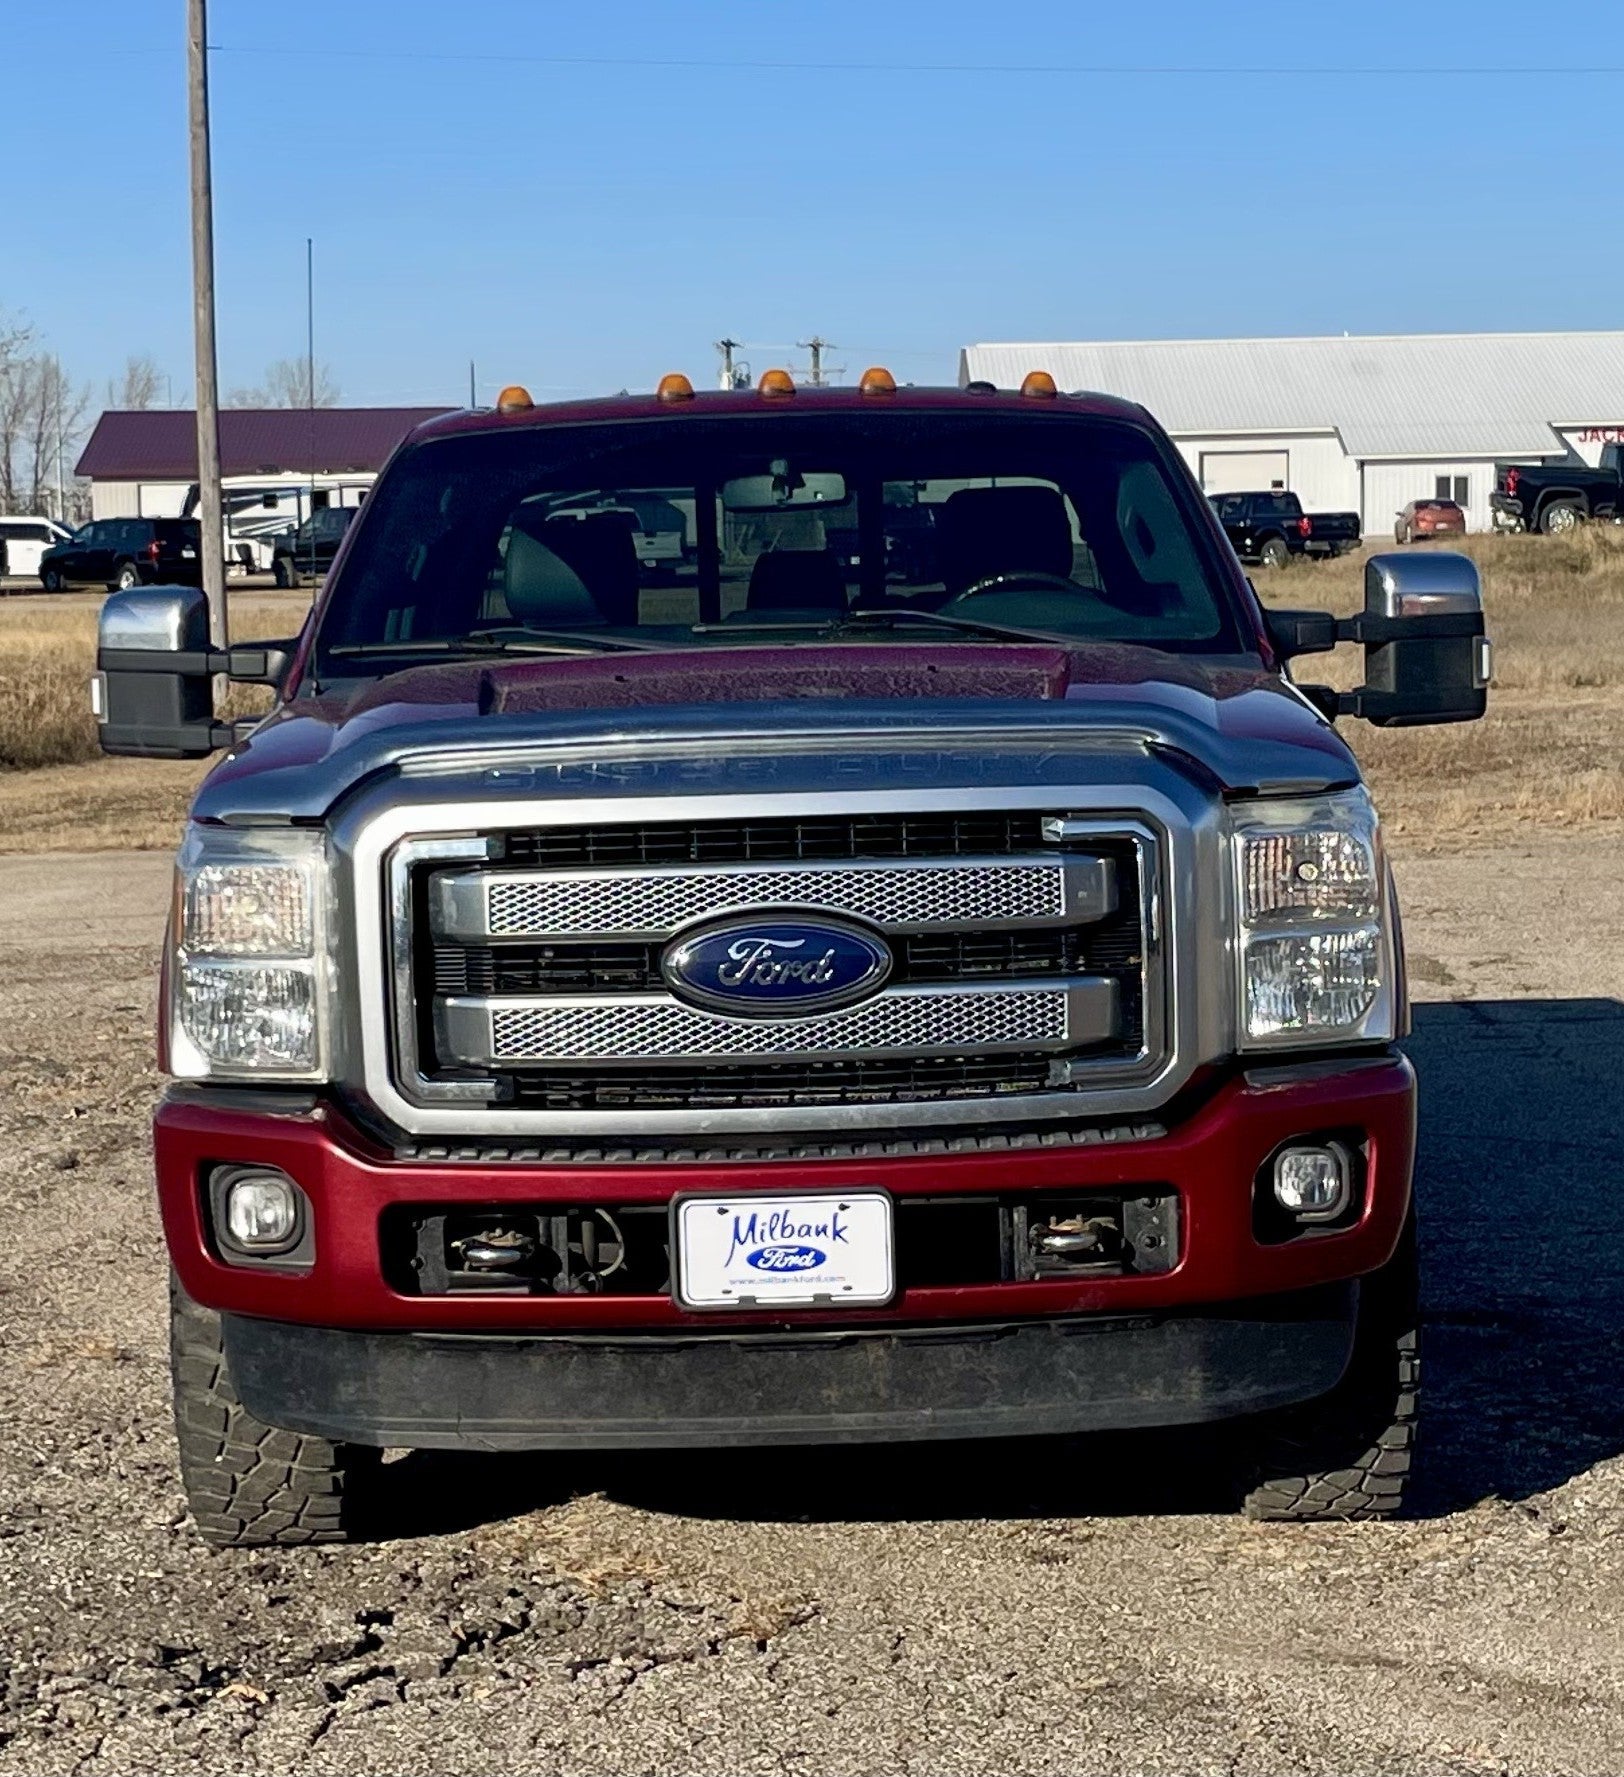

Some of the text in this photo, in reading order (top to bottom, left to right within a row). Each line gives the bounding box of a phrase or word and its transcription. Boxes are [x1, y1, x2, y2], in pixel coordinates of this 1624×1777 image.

[718, 937, 835, 986] Ford
[724, 1209, 849, 1268] Milbank
[757, 1247, 817, 1269] Ford
